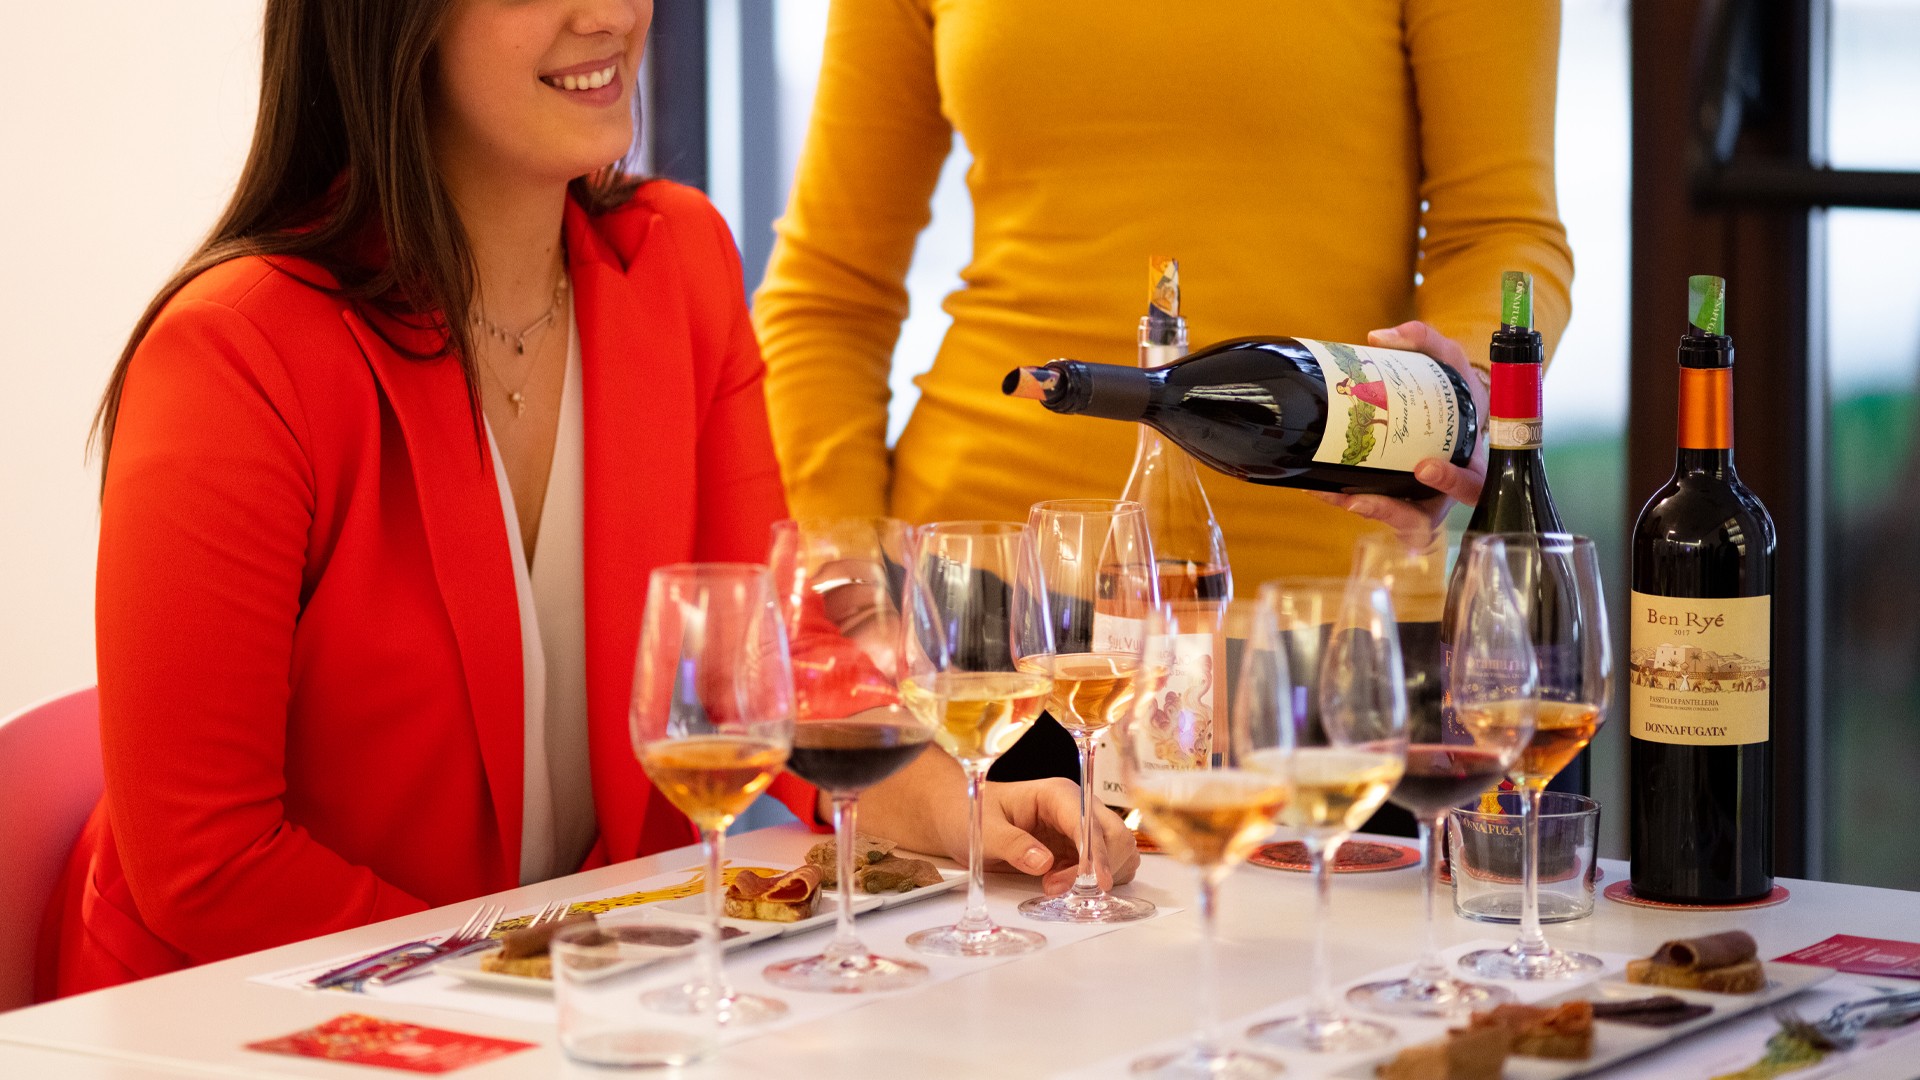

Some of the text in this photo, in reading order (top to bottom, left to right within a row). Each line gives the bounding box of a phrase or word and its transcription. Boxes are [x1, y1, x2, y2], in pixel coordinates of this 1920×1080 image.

[1509, 281, 1524, 334] ONNAFUGAT
[1392, 407, 1409, 444] Vigna
[1647, 608, 1725, 634] Ben Ryé
